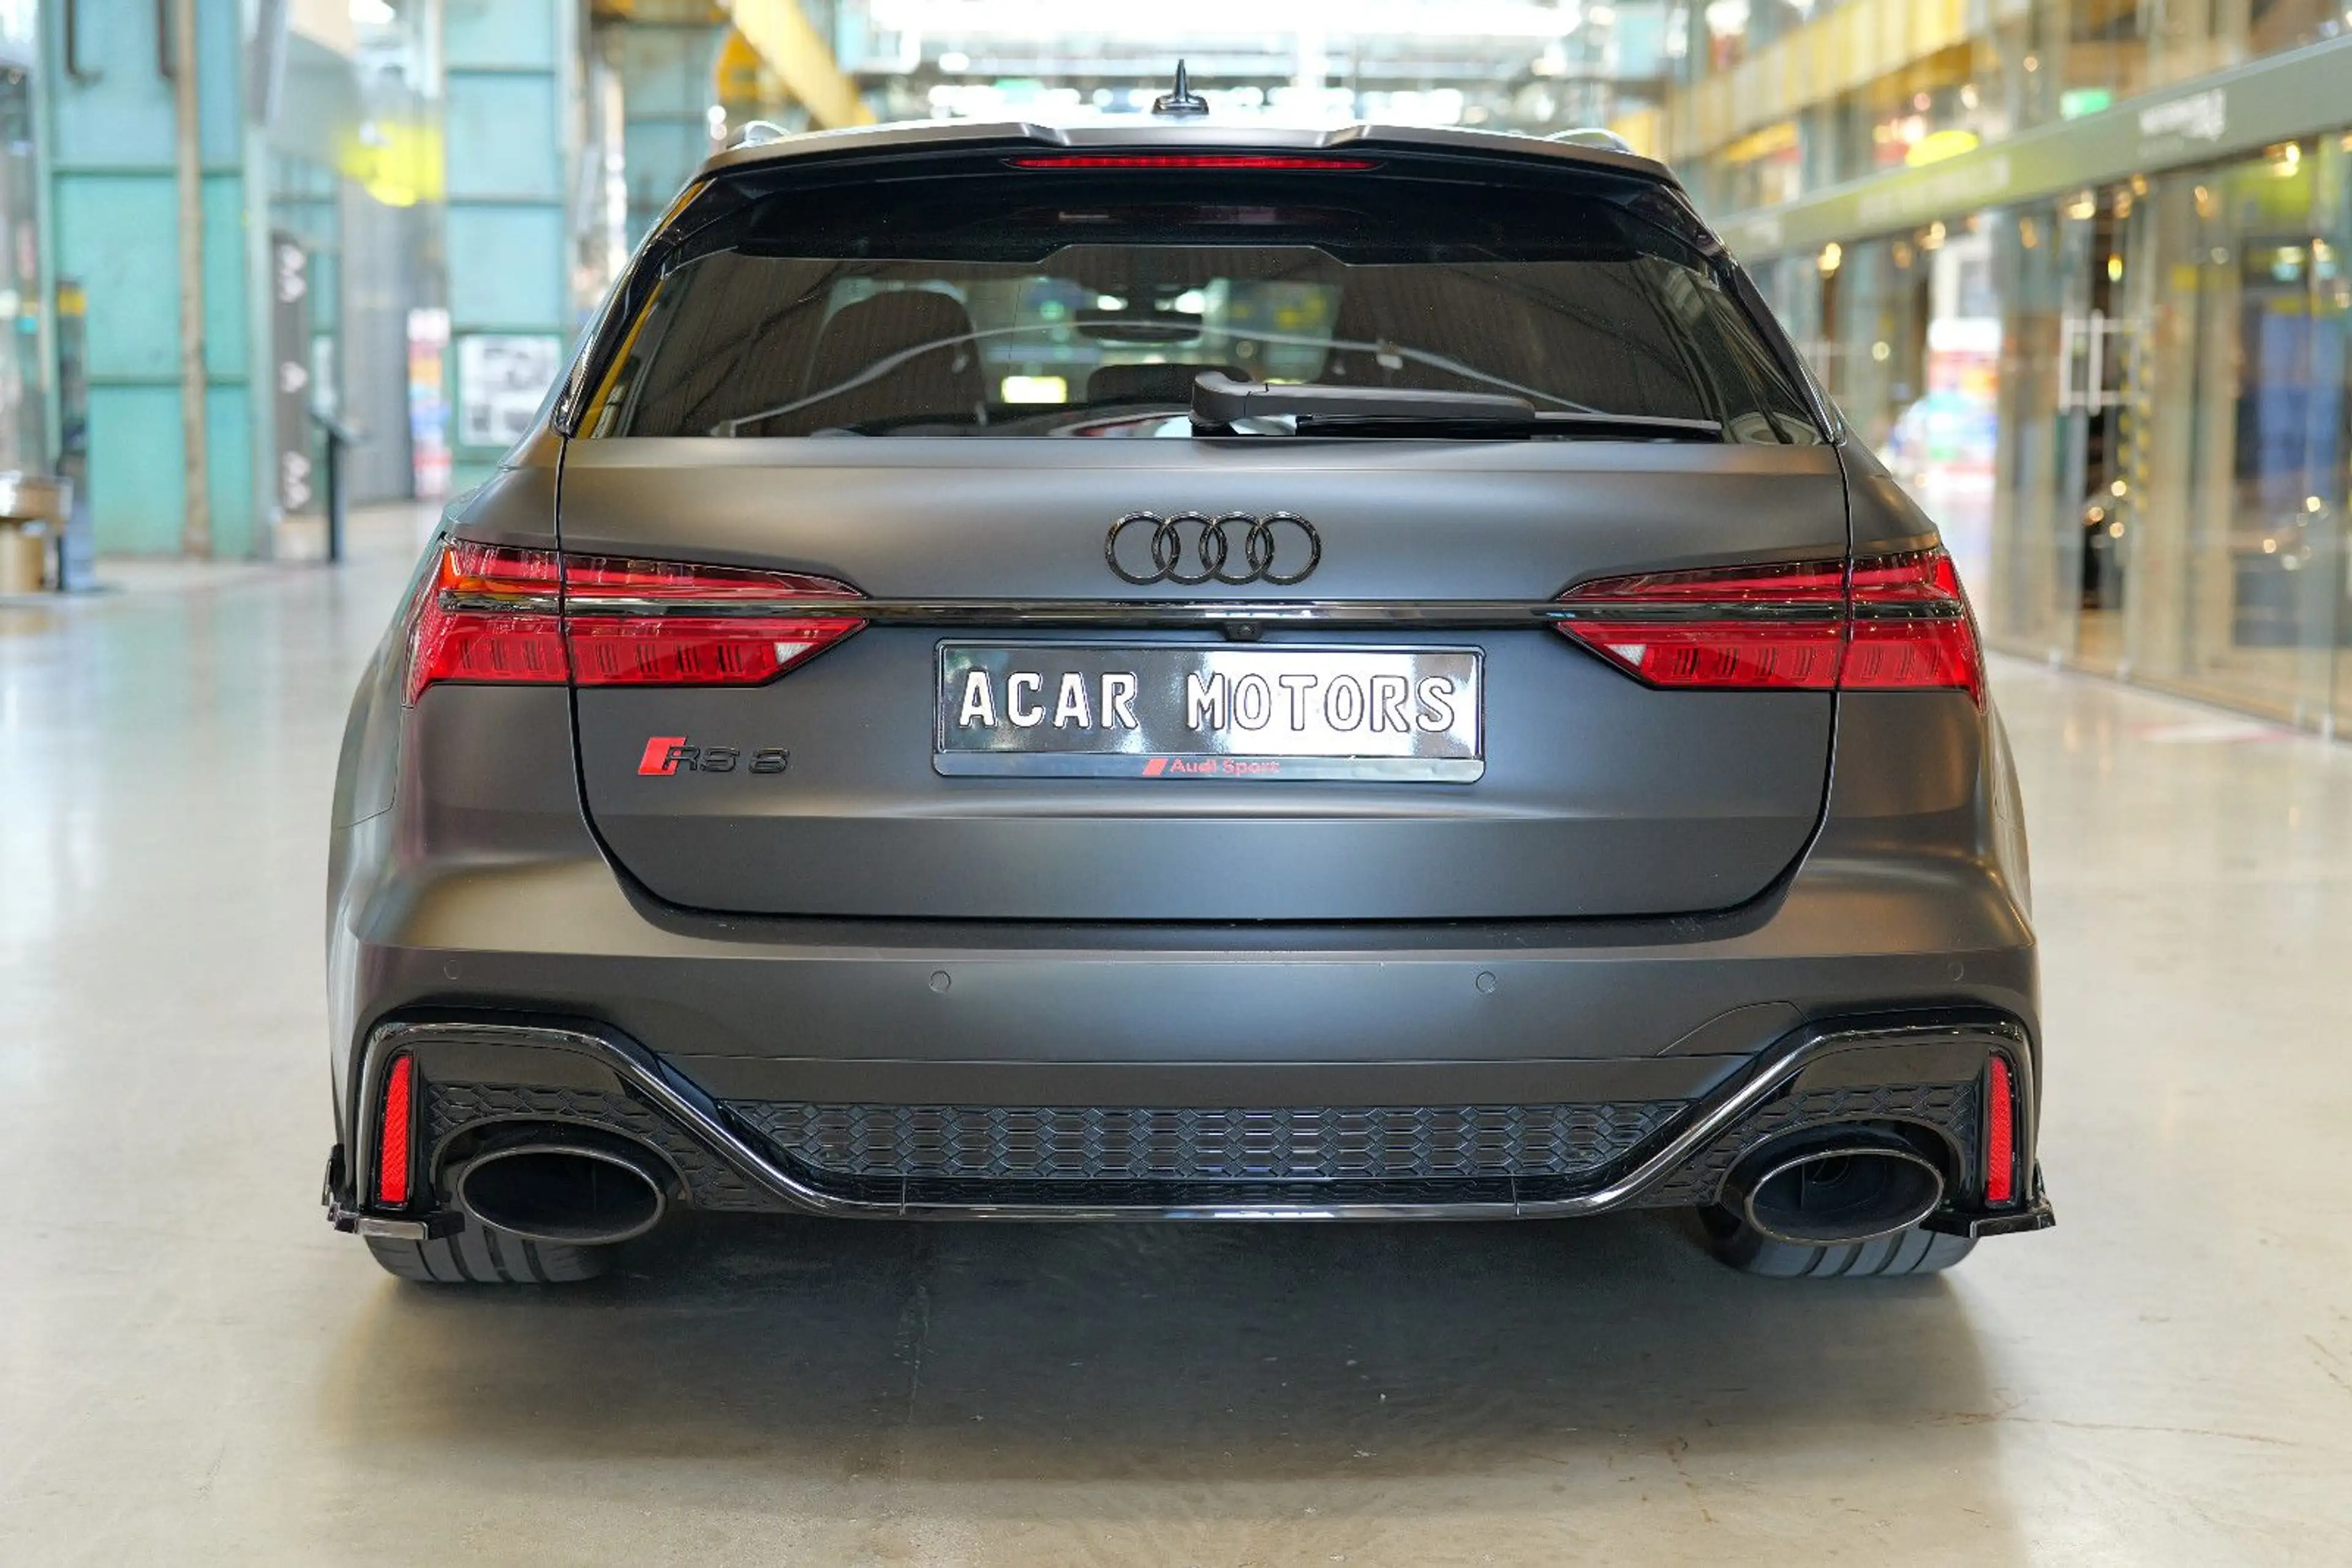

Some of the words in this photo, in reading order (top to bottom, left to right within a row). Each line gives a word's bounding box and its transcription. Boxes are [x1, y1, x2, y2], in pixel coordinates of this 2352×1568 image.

[959, 671, 1139, 729] ACAR
[1186, 673, 1455, 733] MOTORS
[662, 745, 740, 772] RS
[1170, 758, 1217, 773] Audi
[1223, 758, 1280, 777] Sport
